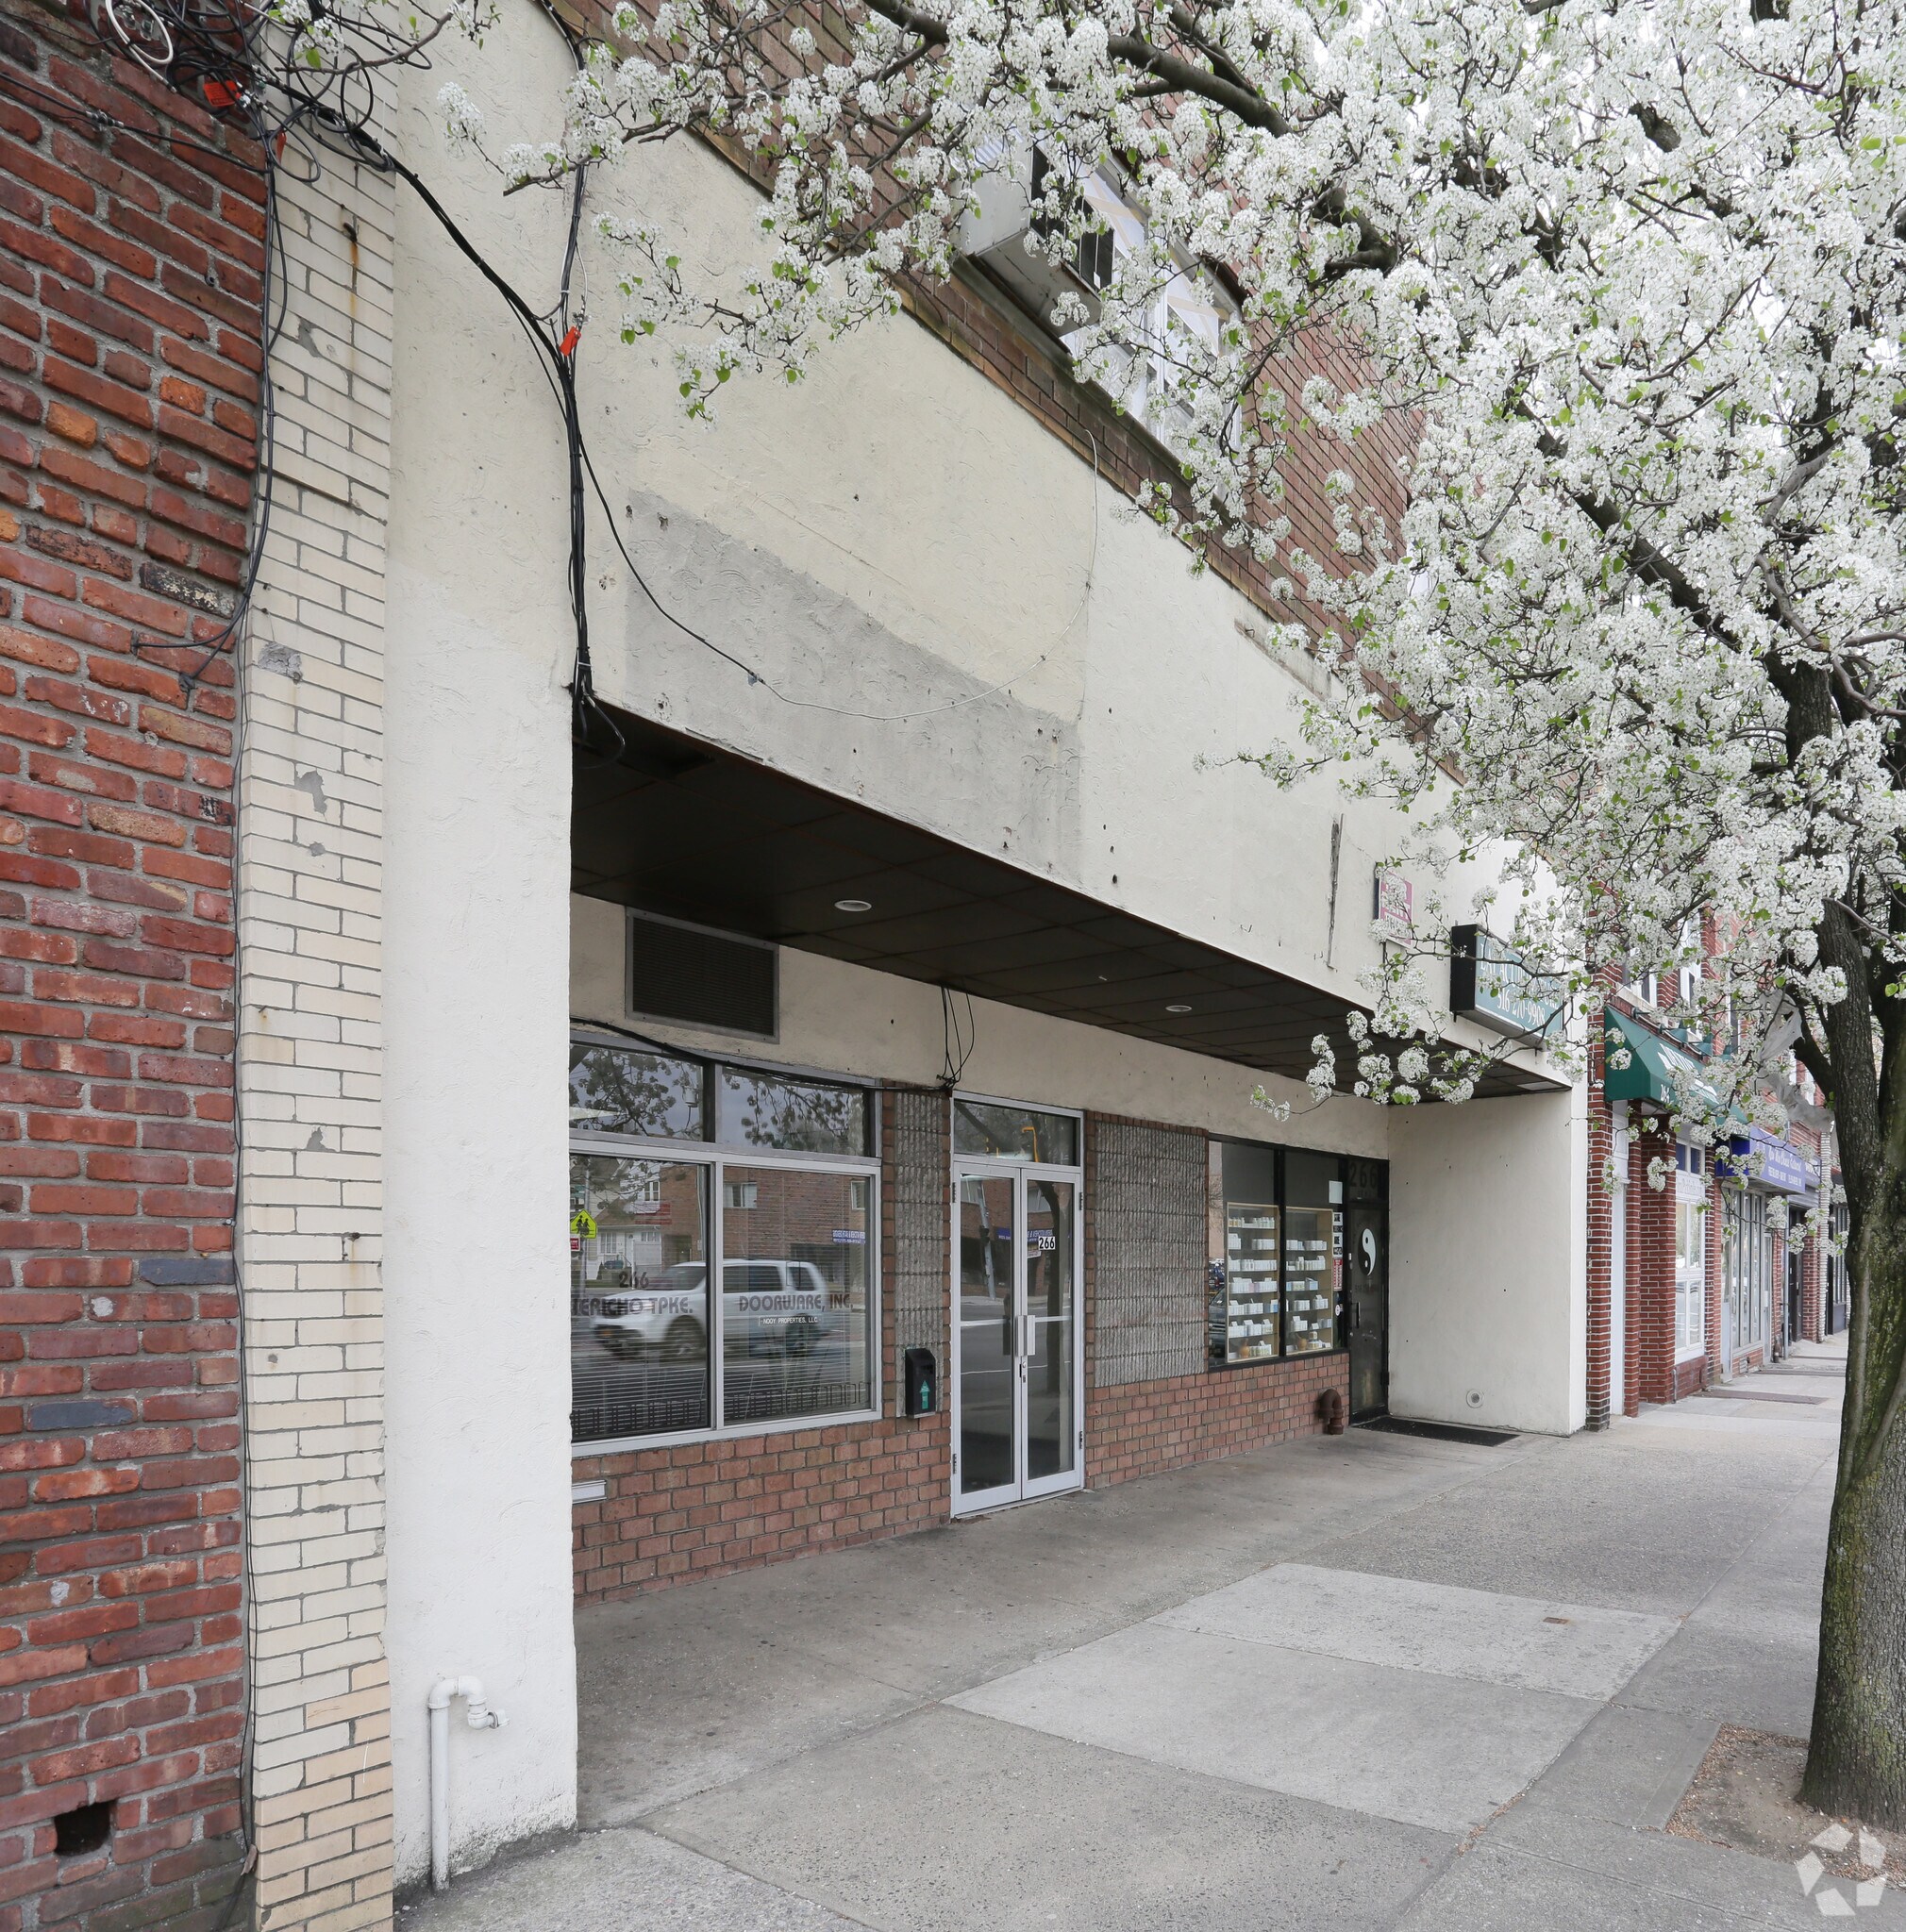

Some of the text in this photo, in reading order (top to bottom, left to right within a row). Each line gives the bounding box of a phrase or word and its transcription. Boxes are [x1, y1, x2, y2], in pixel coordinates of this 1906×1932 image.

[1496, 988, 1511, 1013] 516
[1349, 1162, 1377, 1189] 266
[1039, 1237, 1055, 1249] 266
[619, 1272, 649, 1289] 266
[649, 1297, 694, 1315] TPKE.
[739, 1293, 826, 1312] DOORWARE,
